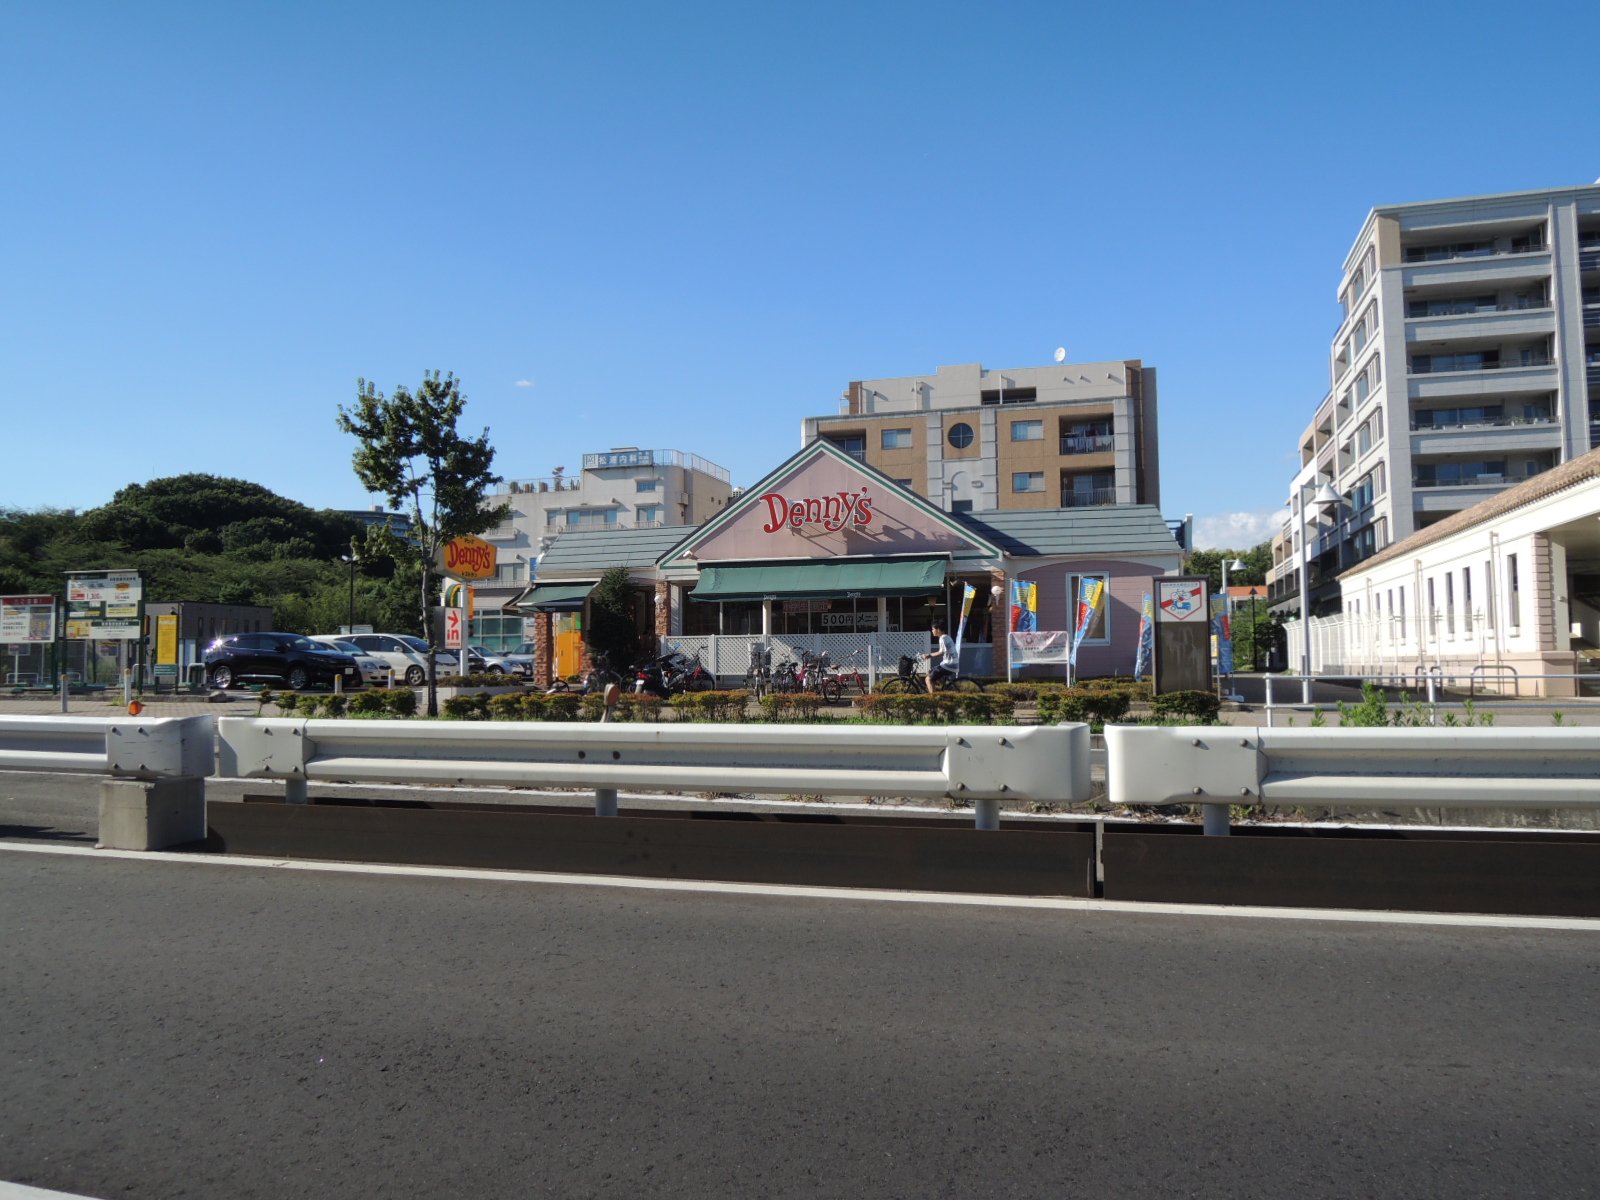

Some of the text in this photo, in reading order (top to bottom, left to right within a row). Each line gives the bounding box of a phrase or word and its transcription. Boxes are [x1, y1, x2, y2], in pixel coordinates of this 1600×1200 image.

[759, 487, 872, 534] Denny's
[448, 541, 489, 571] Denny's
[447, 629, 459, 641] in
